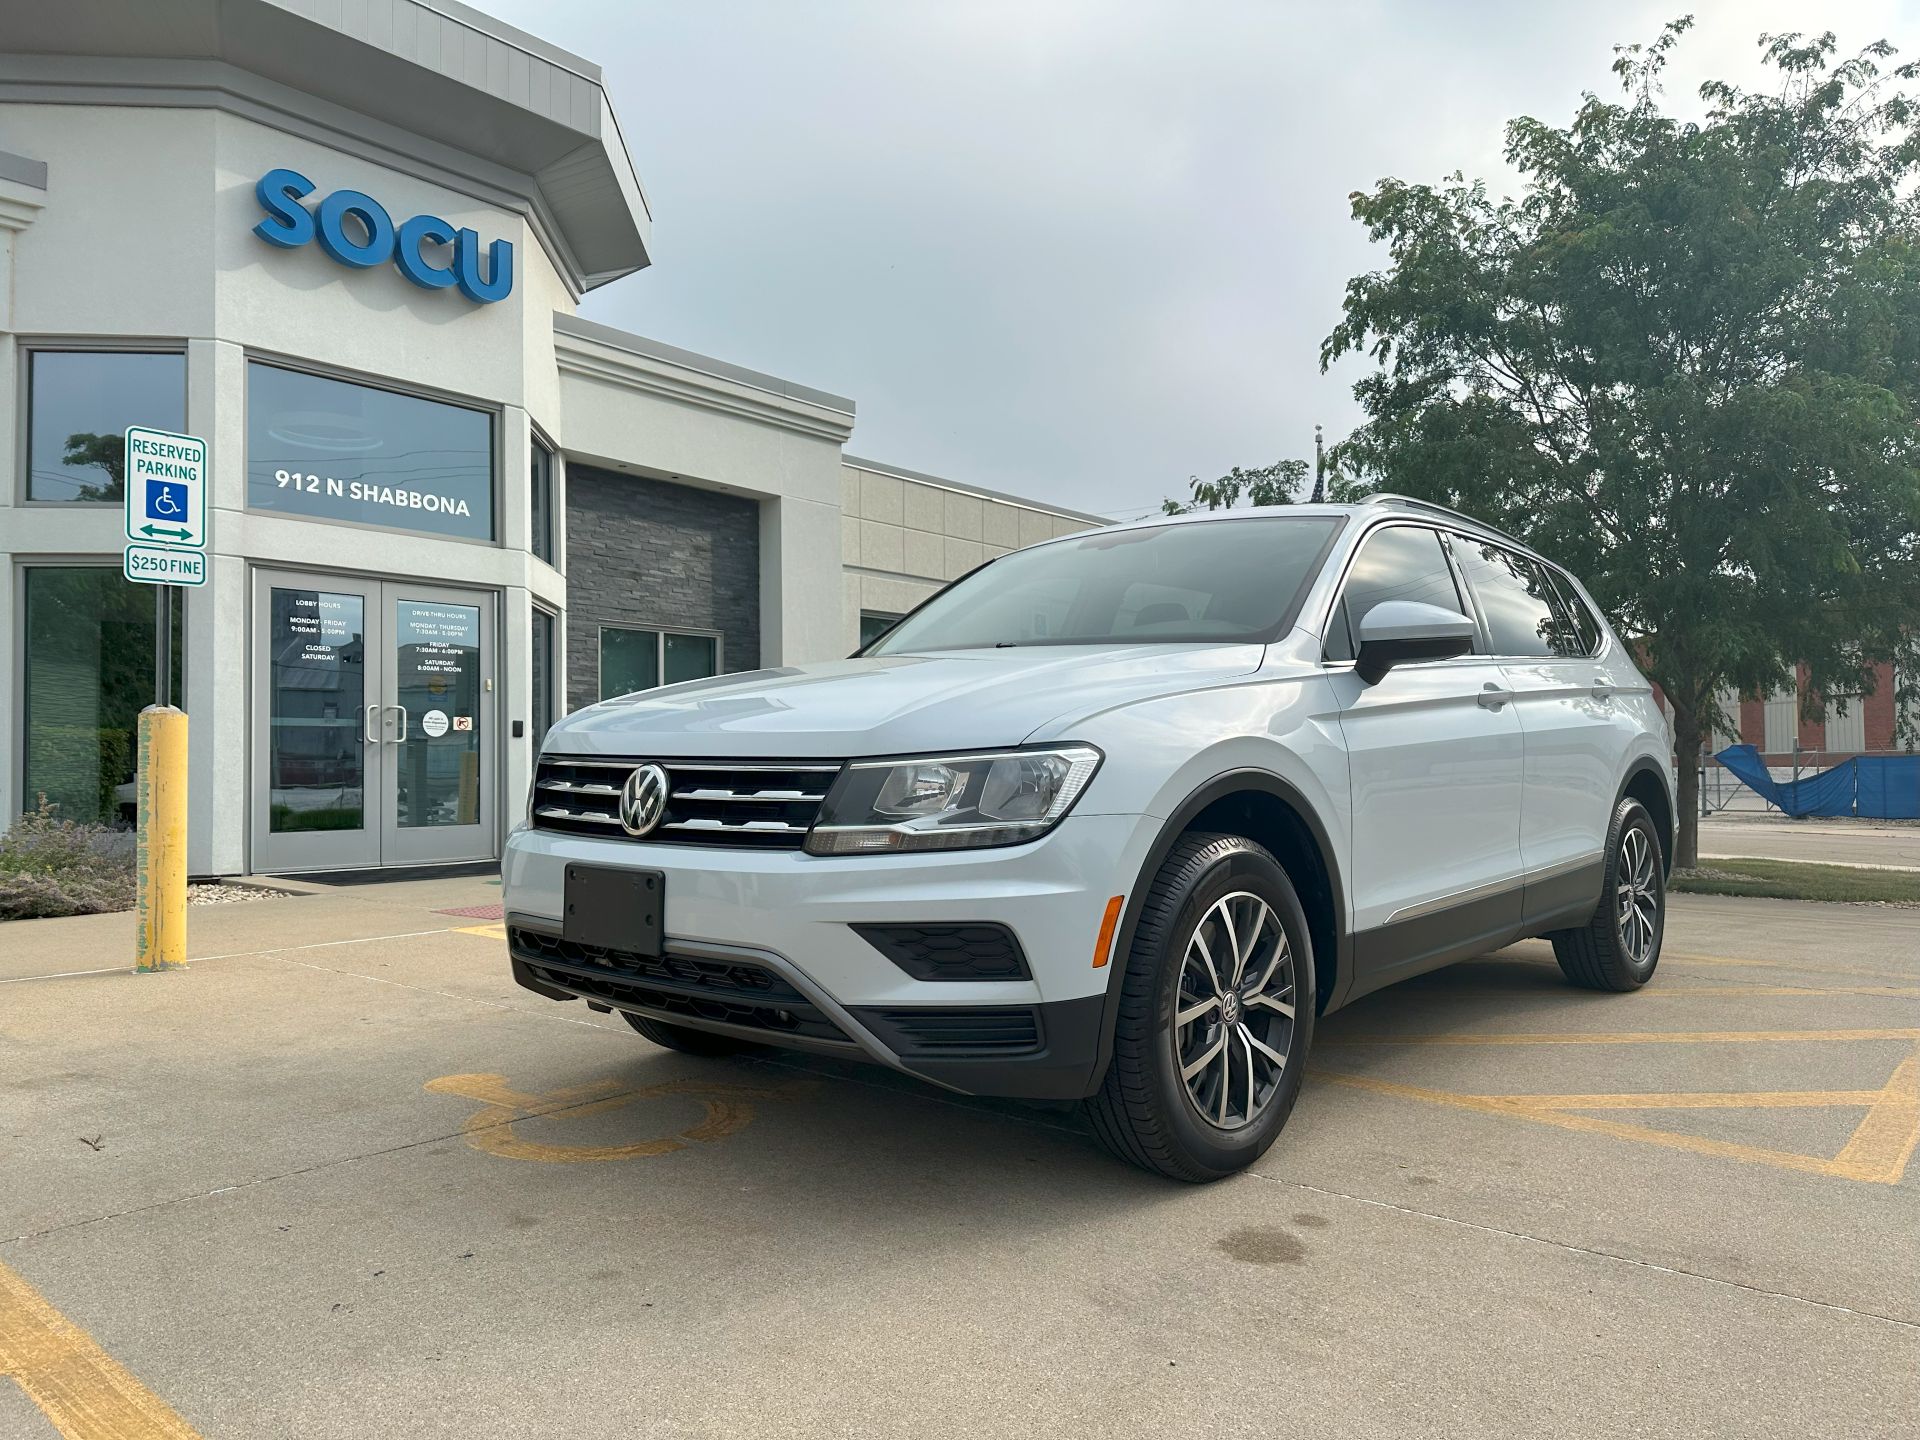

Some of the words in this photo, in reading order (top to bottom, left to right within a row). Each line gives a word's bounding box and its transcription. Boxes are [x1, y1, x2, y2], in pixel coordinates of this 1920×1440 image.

[252, 168, 513, 304] SOCU
[132, 438, 201, 463] RESERVED
[137, 459, 197, 481] PARKING
[275, 469, 320, 494] 912
[326, 478, 343, 497] N
[349, 482, 471, 517] SHABBONA
[131, 554, 168, 572] $250
[170, 559, 201, 575] FINE
[446, 612, 467, 620] HOURS
[439, 624, 469, 632] THURSDAY
